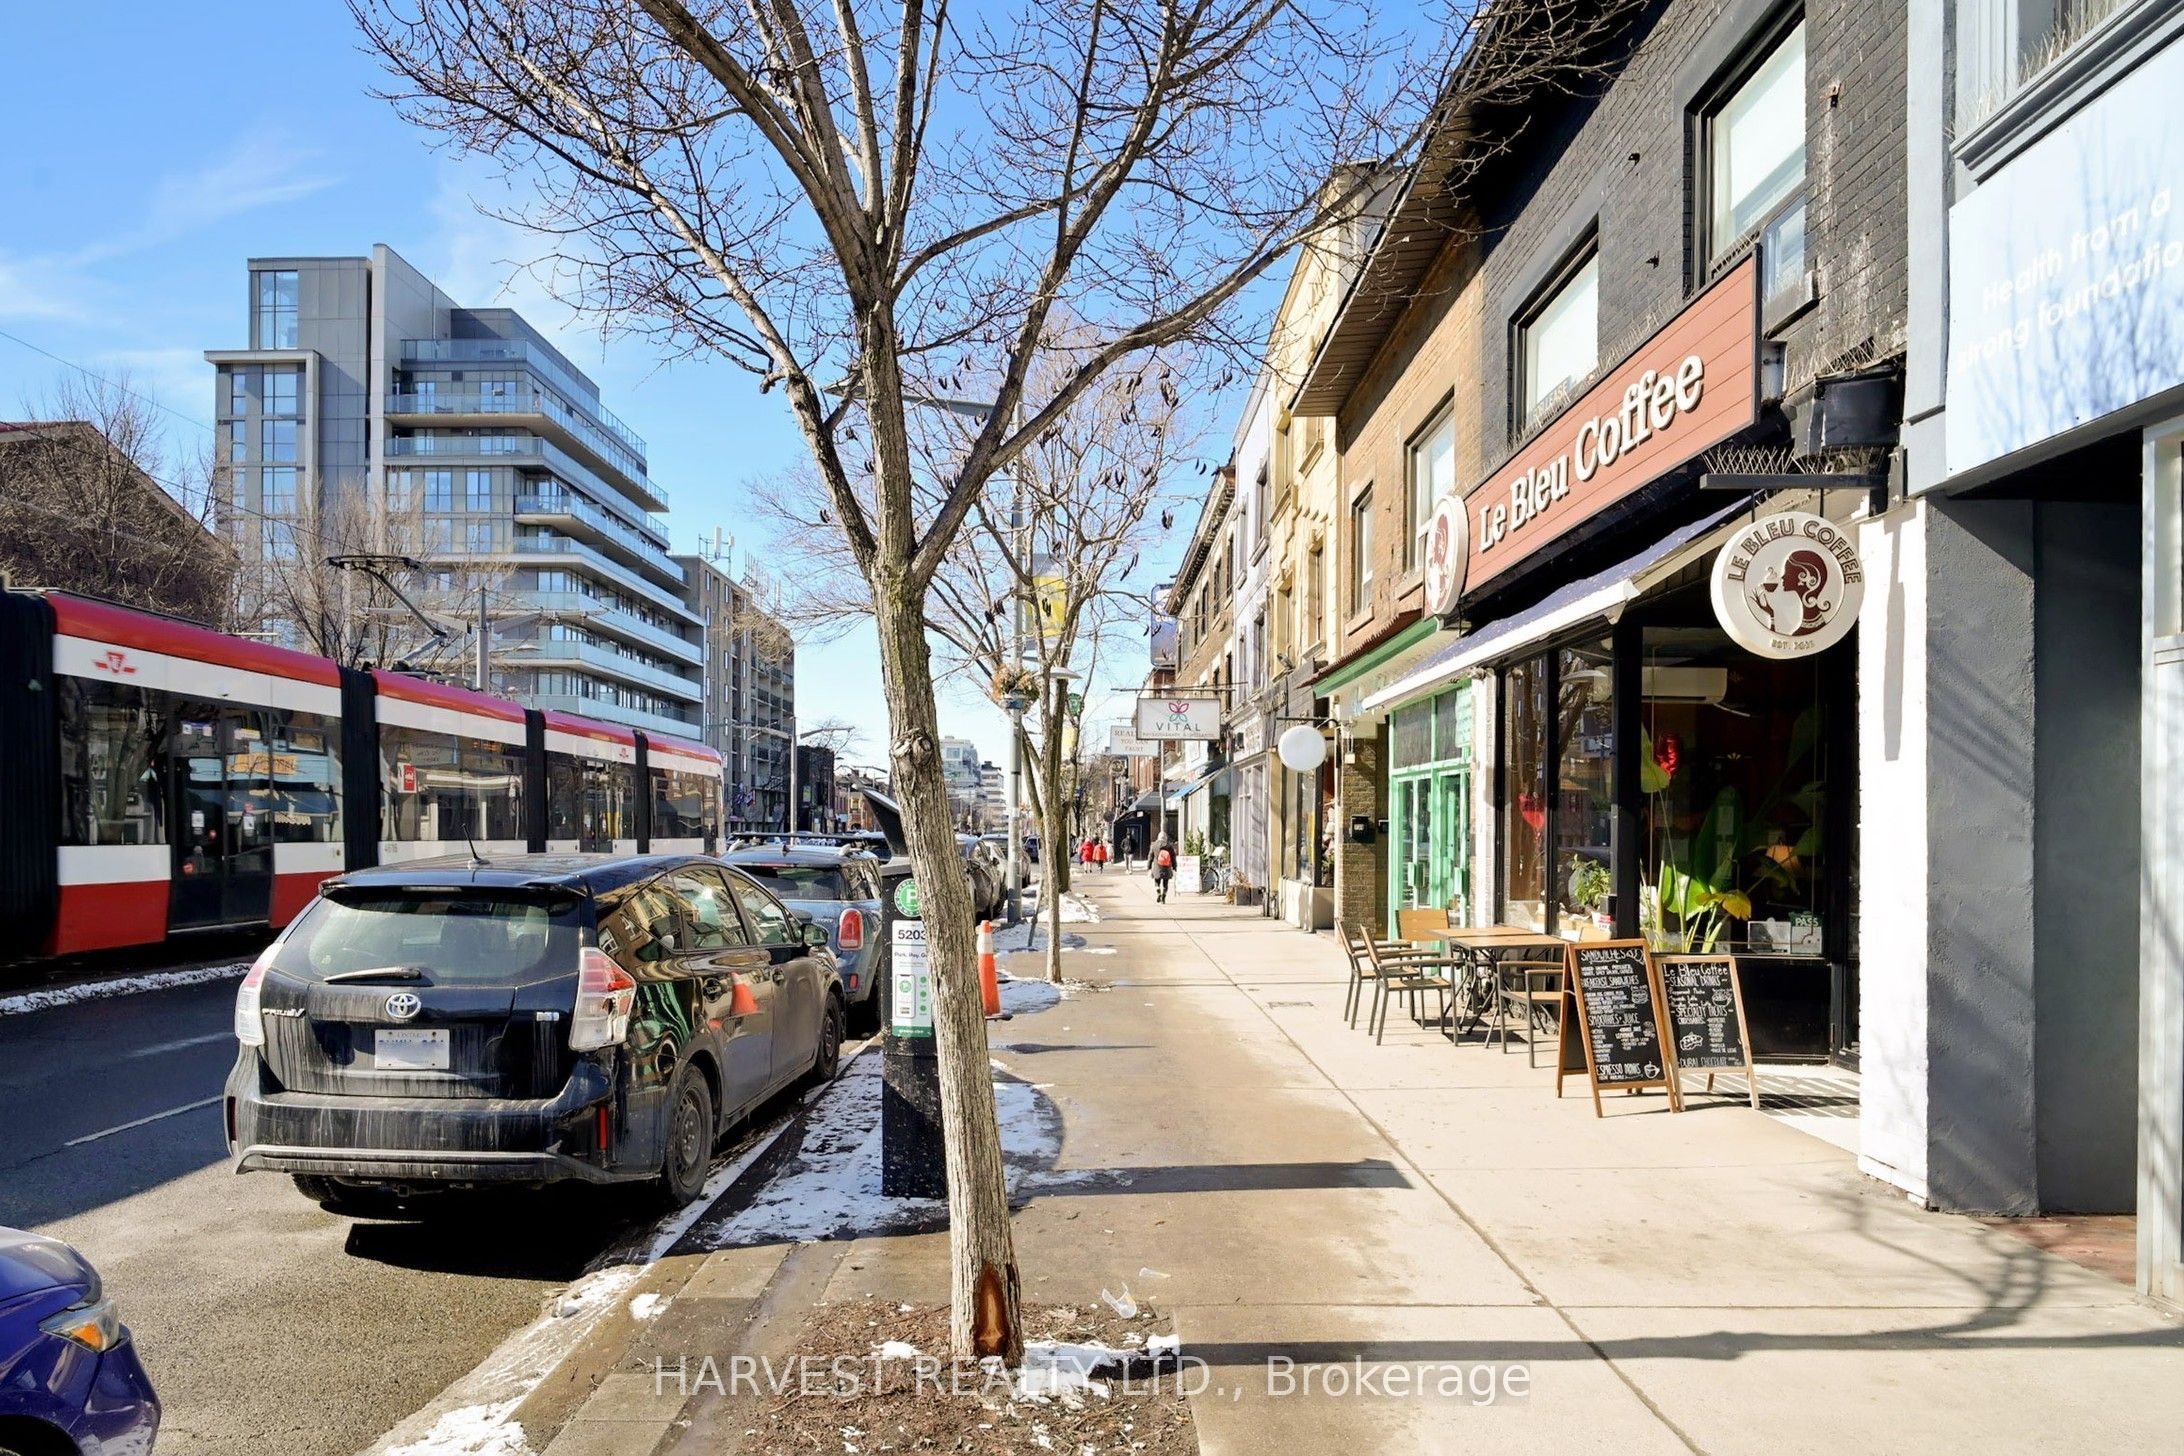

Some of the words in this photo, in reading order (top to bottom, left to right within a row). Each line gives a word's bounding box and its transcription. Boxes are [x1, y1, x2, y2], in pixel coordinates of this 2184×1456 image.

[1983, 247, 2063, 314] Health
[2071, 206, 2139, 263] from
[1478, 504, 1506, 552] Le
[1510, 455, 1569, 531] Bleu
[1574, 354, 1704, 481] Coffee
[1728, 556, 1750, 581] LE
[1741, 518, 1794, 556] BLEU
[1803, 520, 1862, 584] COFFEE
[1156, 722, 1201, 732] VITAL
[1795, 917, 1819, 927] PASS
[1663, 964, 1675, 977] Le
[1678, 963, 1700, 977] Bleu
[1700, 963, 1728, 976] Coffee
